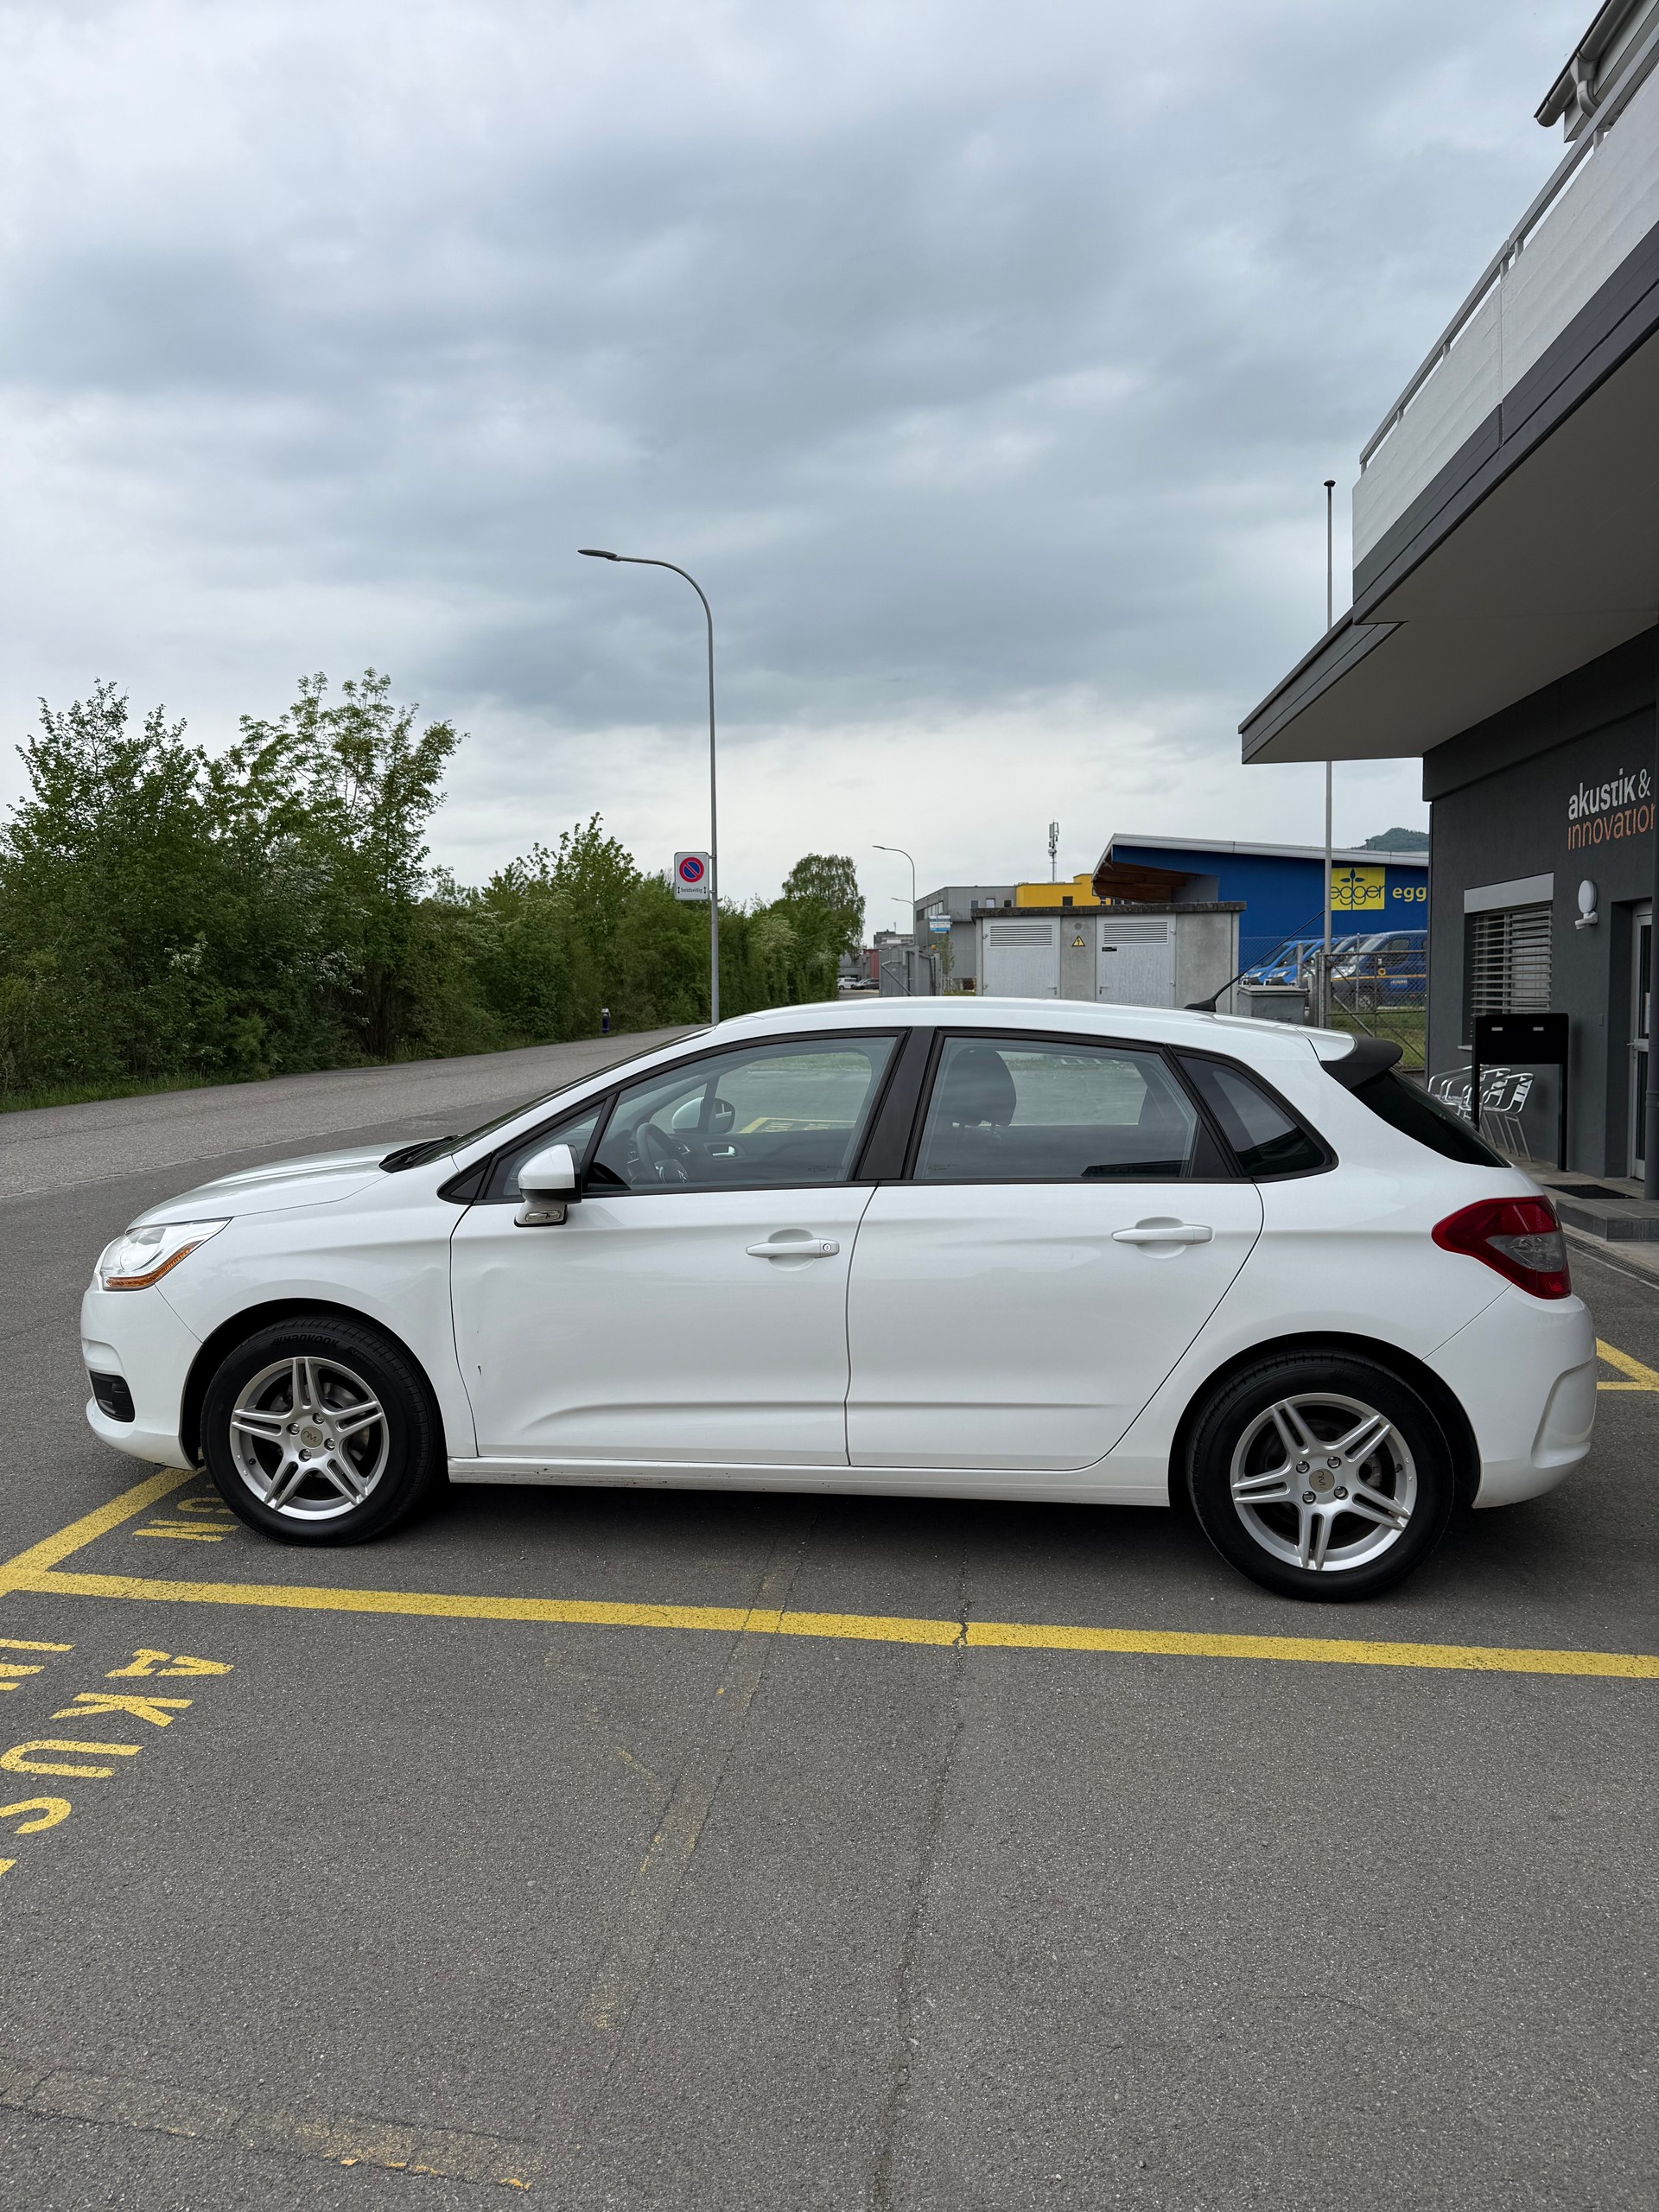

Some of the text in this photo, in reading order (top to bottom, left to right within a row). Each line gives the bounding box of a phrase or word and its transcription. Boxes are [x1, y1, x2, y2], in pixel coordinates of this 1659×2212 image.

[1568, 768, 1651, 820] akustik &
[1331, 885, 1385, 906] egger
[0, 1648, 234, 1877] AKUS
